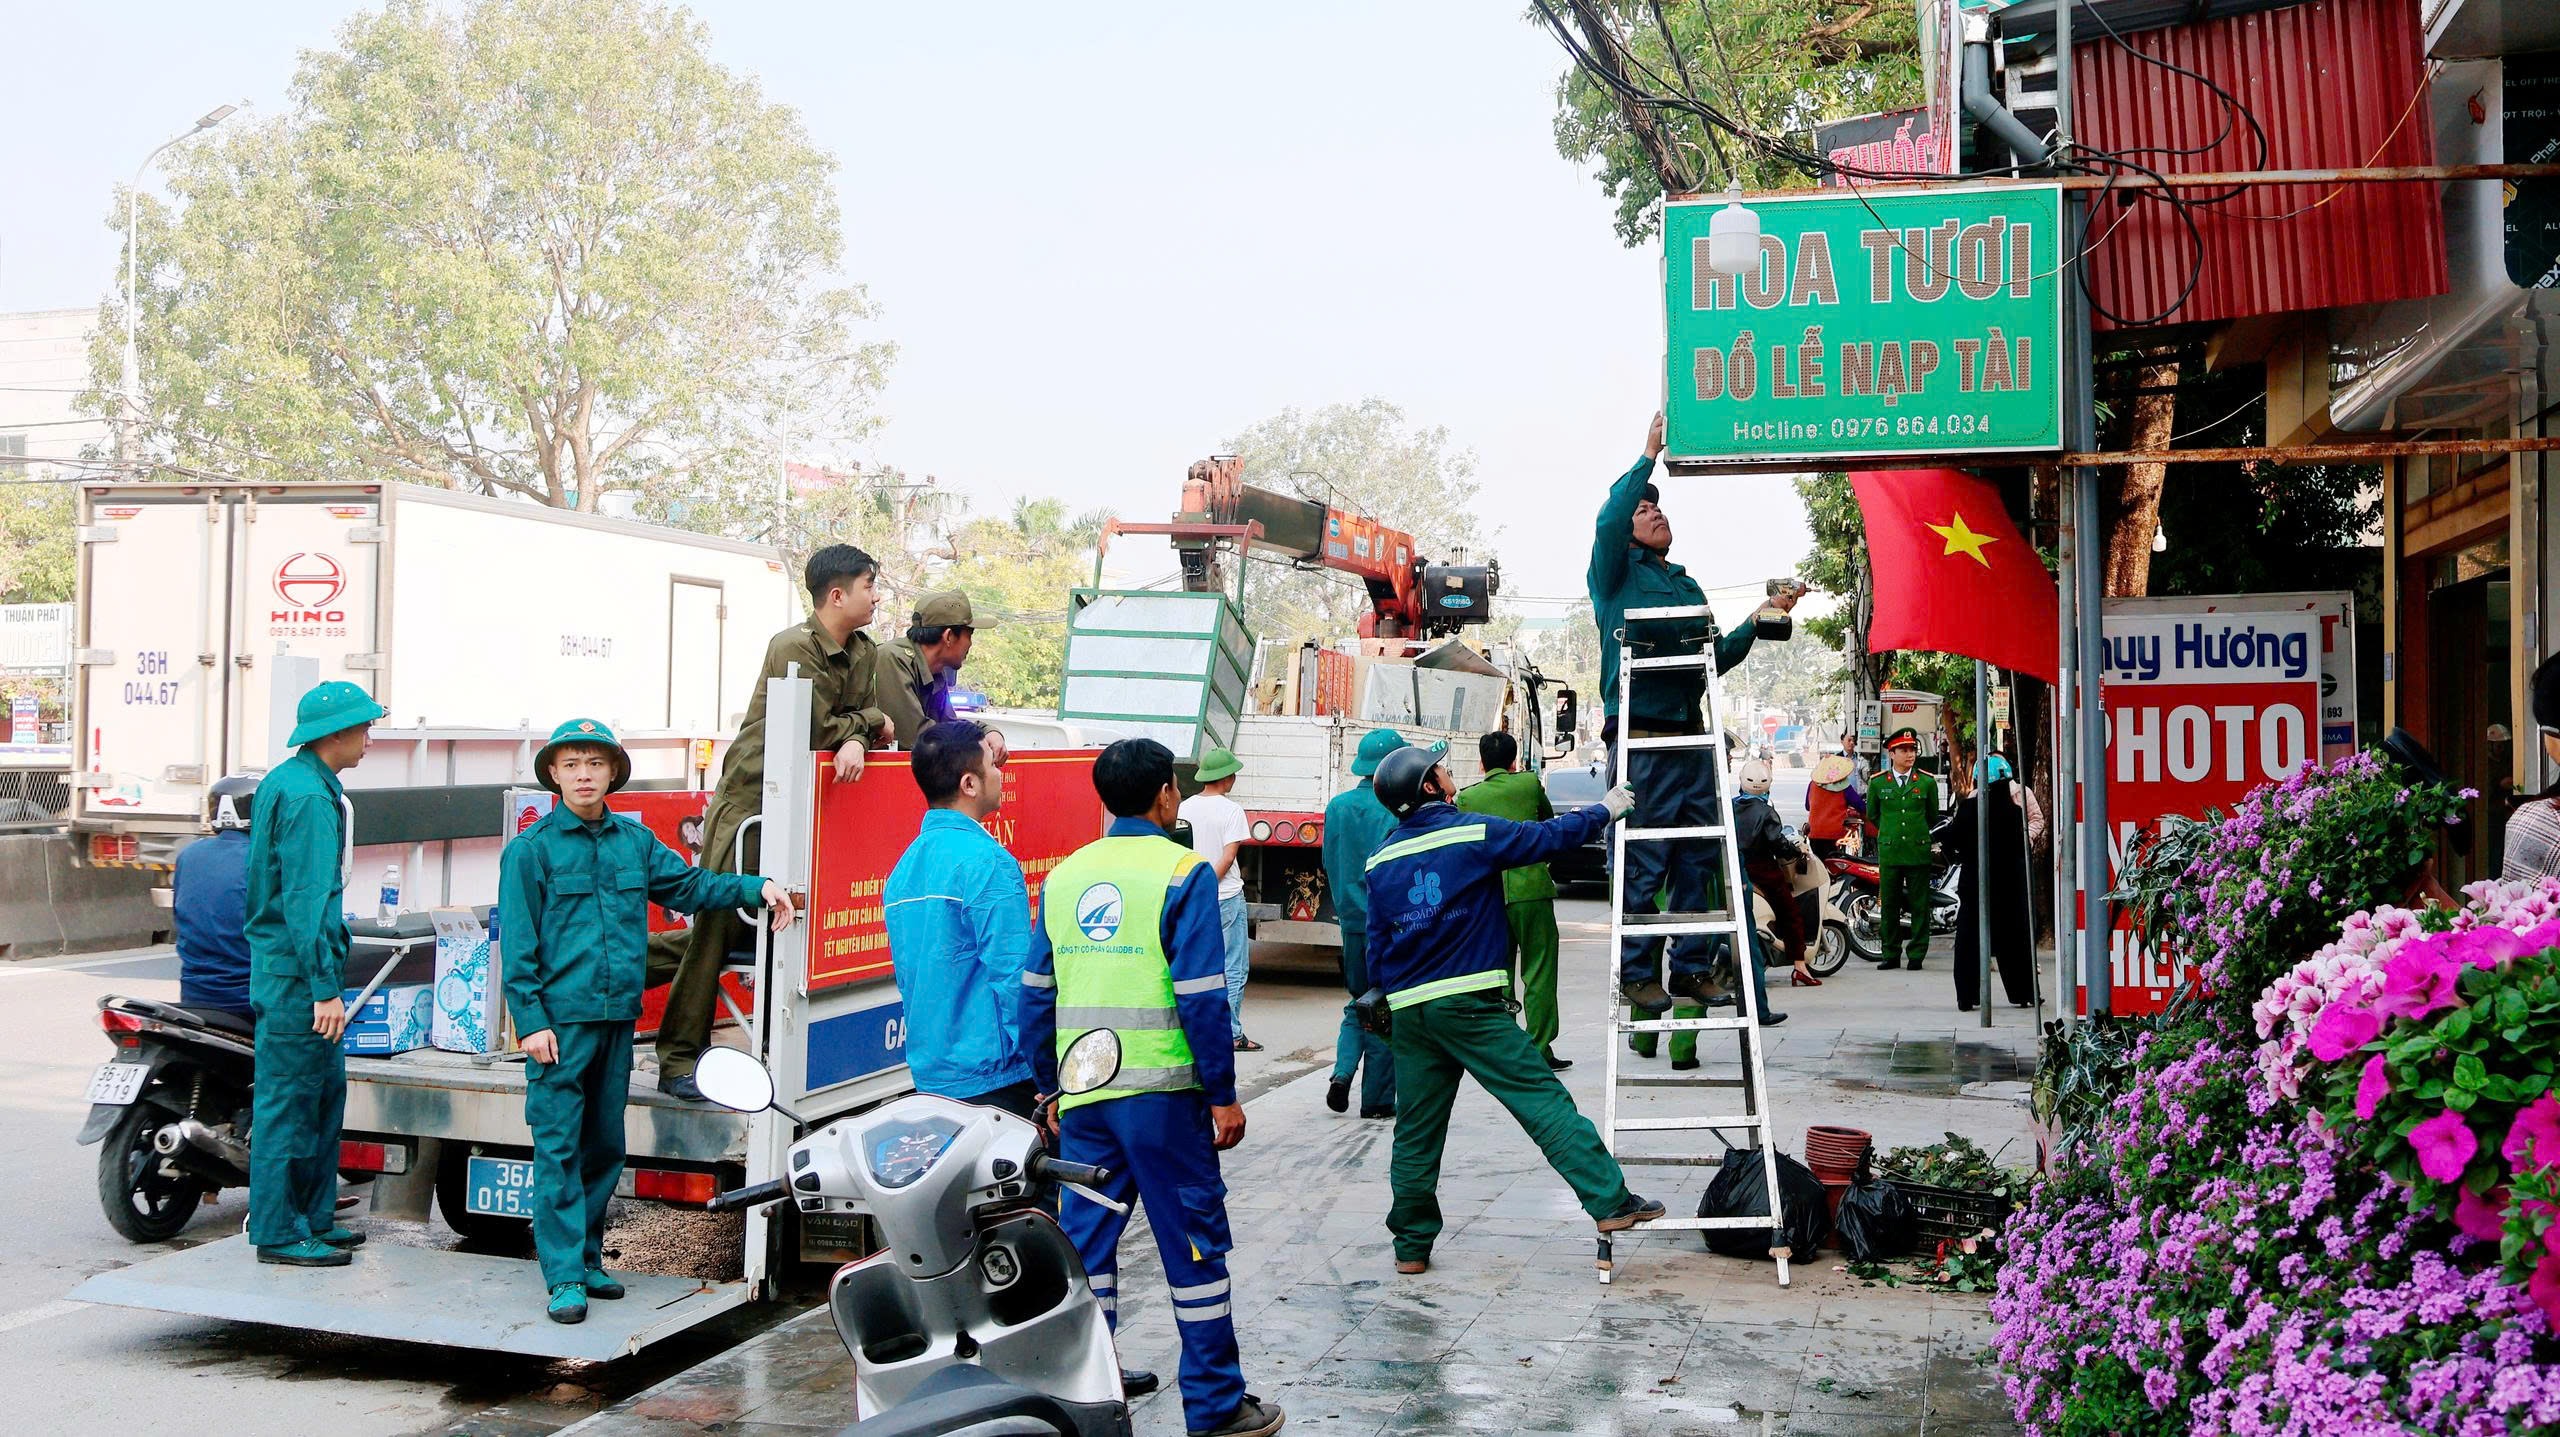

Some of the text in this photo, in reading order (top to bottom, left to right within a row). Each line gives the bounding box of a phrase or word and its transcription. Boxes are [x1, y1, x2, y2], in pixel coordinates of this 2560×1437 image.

[1691, 215, 2032, 311] HOA TƯƠI
[1693, 324, 2032, 407] ĐỒ LỄ NẠP TÀI
[1733, 414, 1991, 442] Hotline: 0976 864.034
[270, 610, 345, 622] HINO
[136, 651, 168, 675] 36H
[2174, 623, 2307, 678] Hương
[124, 682, 179, 706] 044.67
